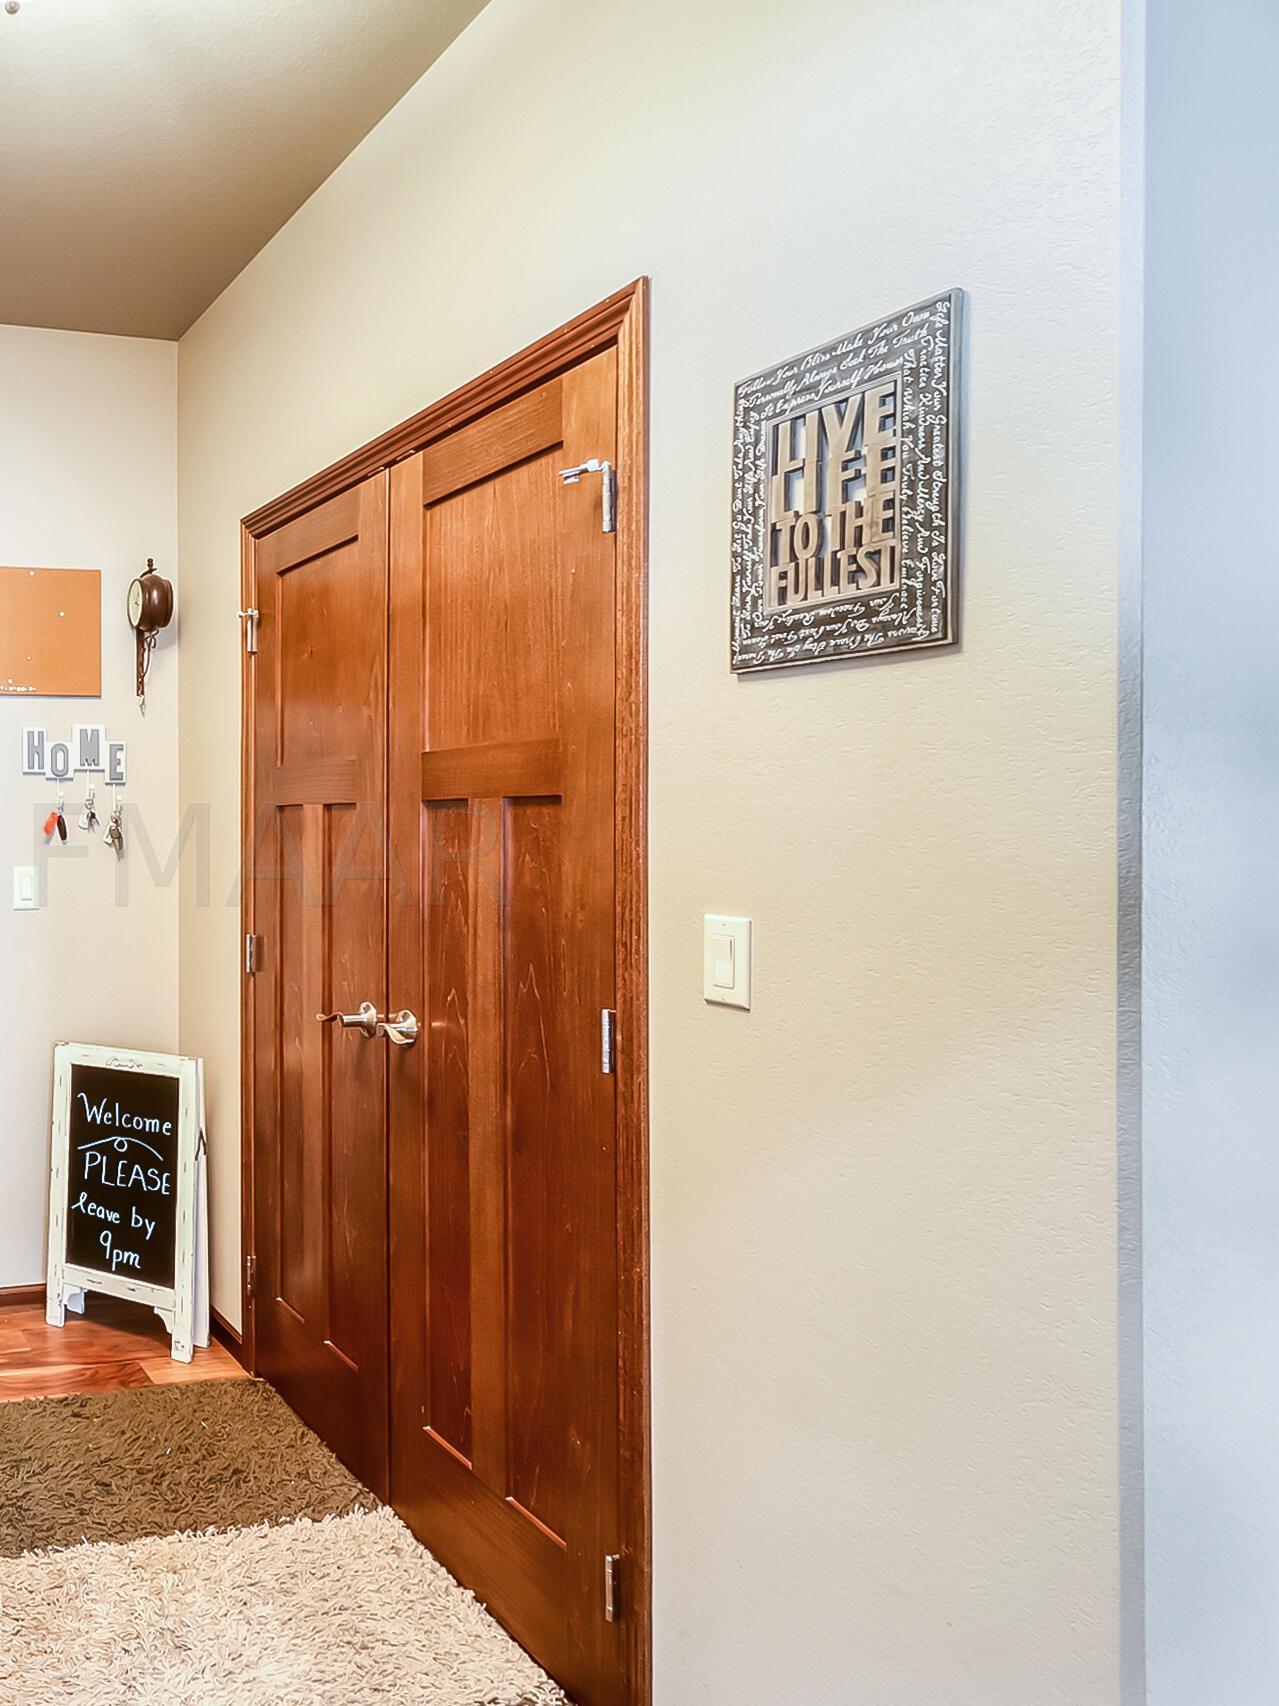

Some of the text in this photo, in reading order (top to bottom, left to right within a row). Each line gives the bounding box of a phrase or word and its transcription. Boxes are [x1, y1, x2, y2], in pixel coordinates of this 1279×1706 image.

[777, 381, 896, 476] LIVE
[771, 443, 896, 523] LIFE
[776, 490, 896, 566] TO THE
[771, 540, 896, 606] FULLEST
[27, 729, 124, 781] HOME
[77, 1092, 172, 1136] Welcome
[84, 1151, 170, 1195] PLEASE
[71, 1191, 156, 1240] leave by
[100, 1230, 141, 1271] 9pm
